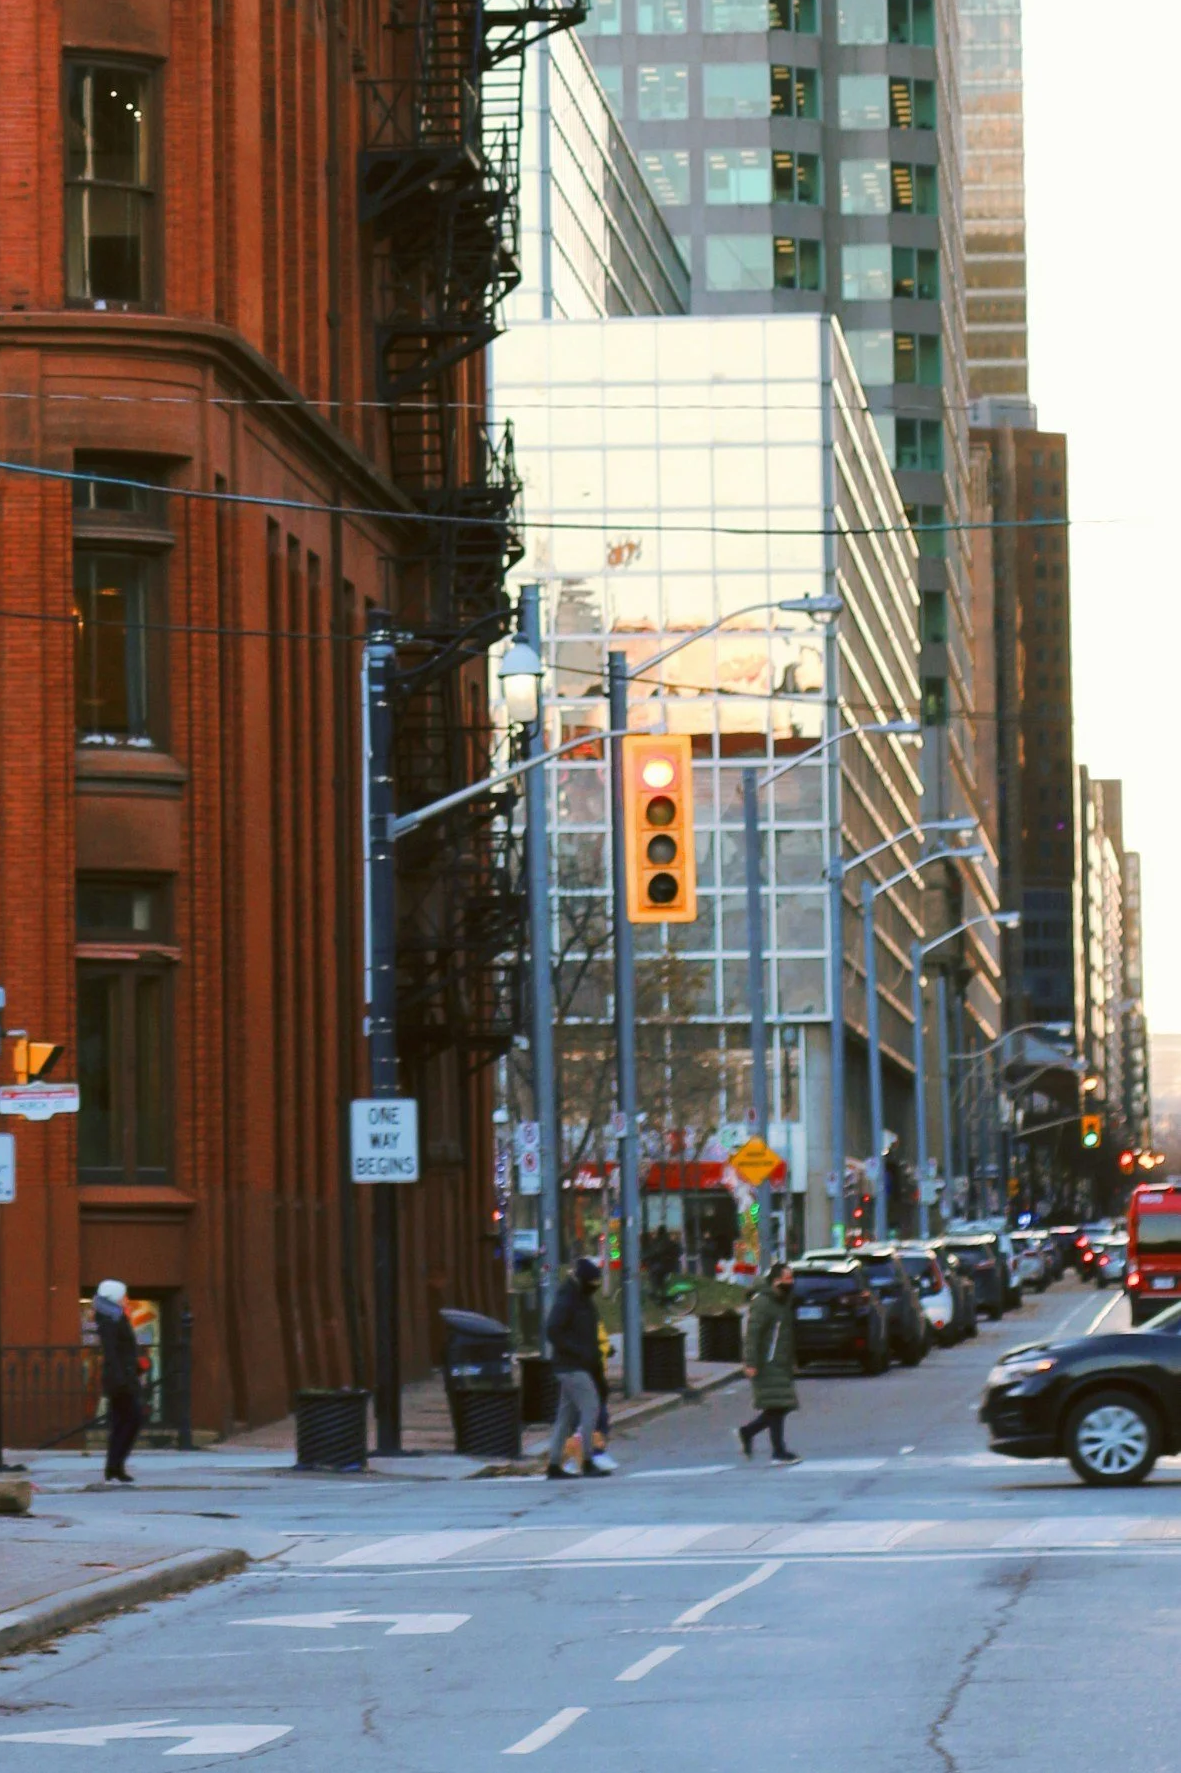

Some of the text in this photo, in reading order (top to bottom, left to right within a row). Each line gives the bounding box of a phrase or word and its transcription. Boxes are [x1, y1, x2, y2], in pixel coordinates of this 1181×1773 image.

[368, 1107, 401, 1125] ONE
[368, 1132, 401, 1149] WAY
[356, 1156, 415, 1175] BEGINS
